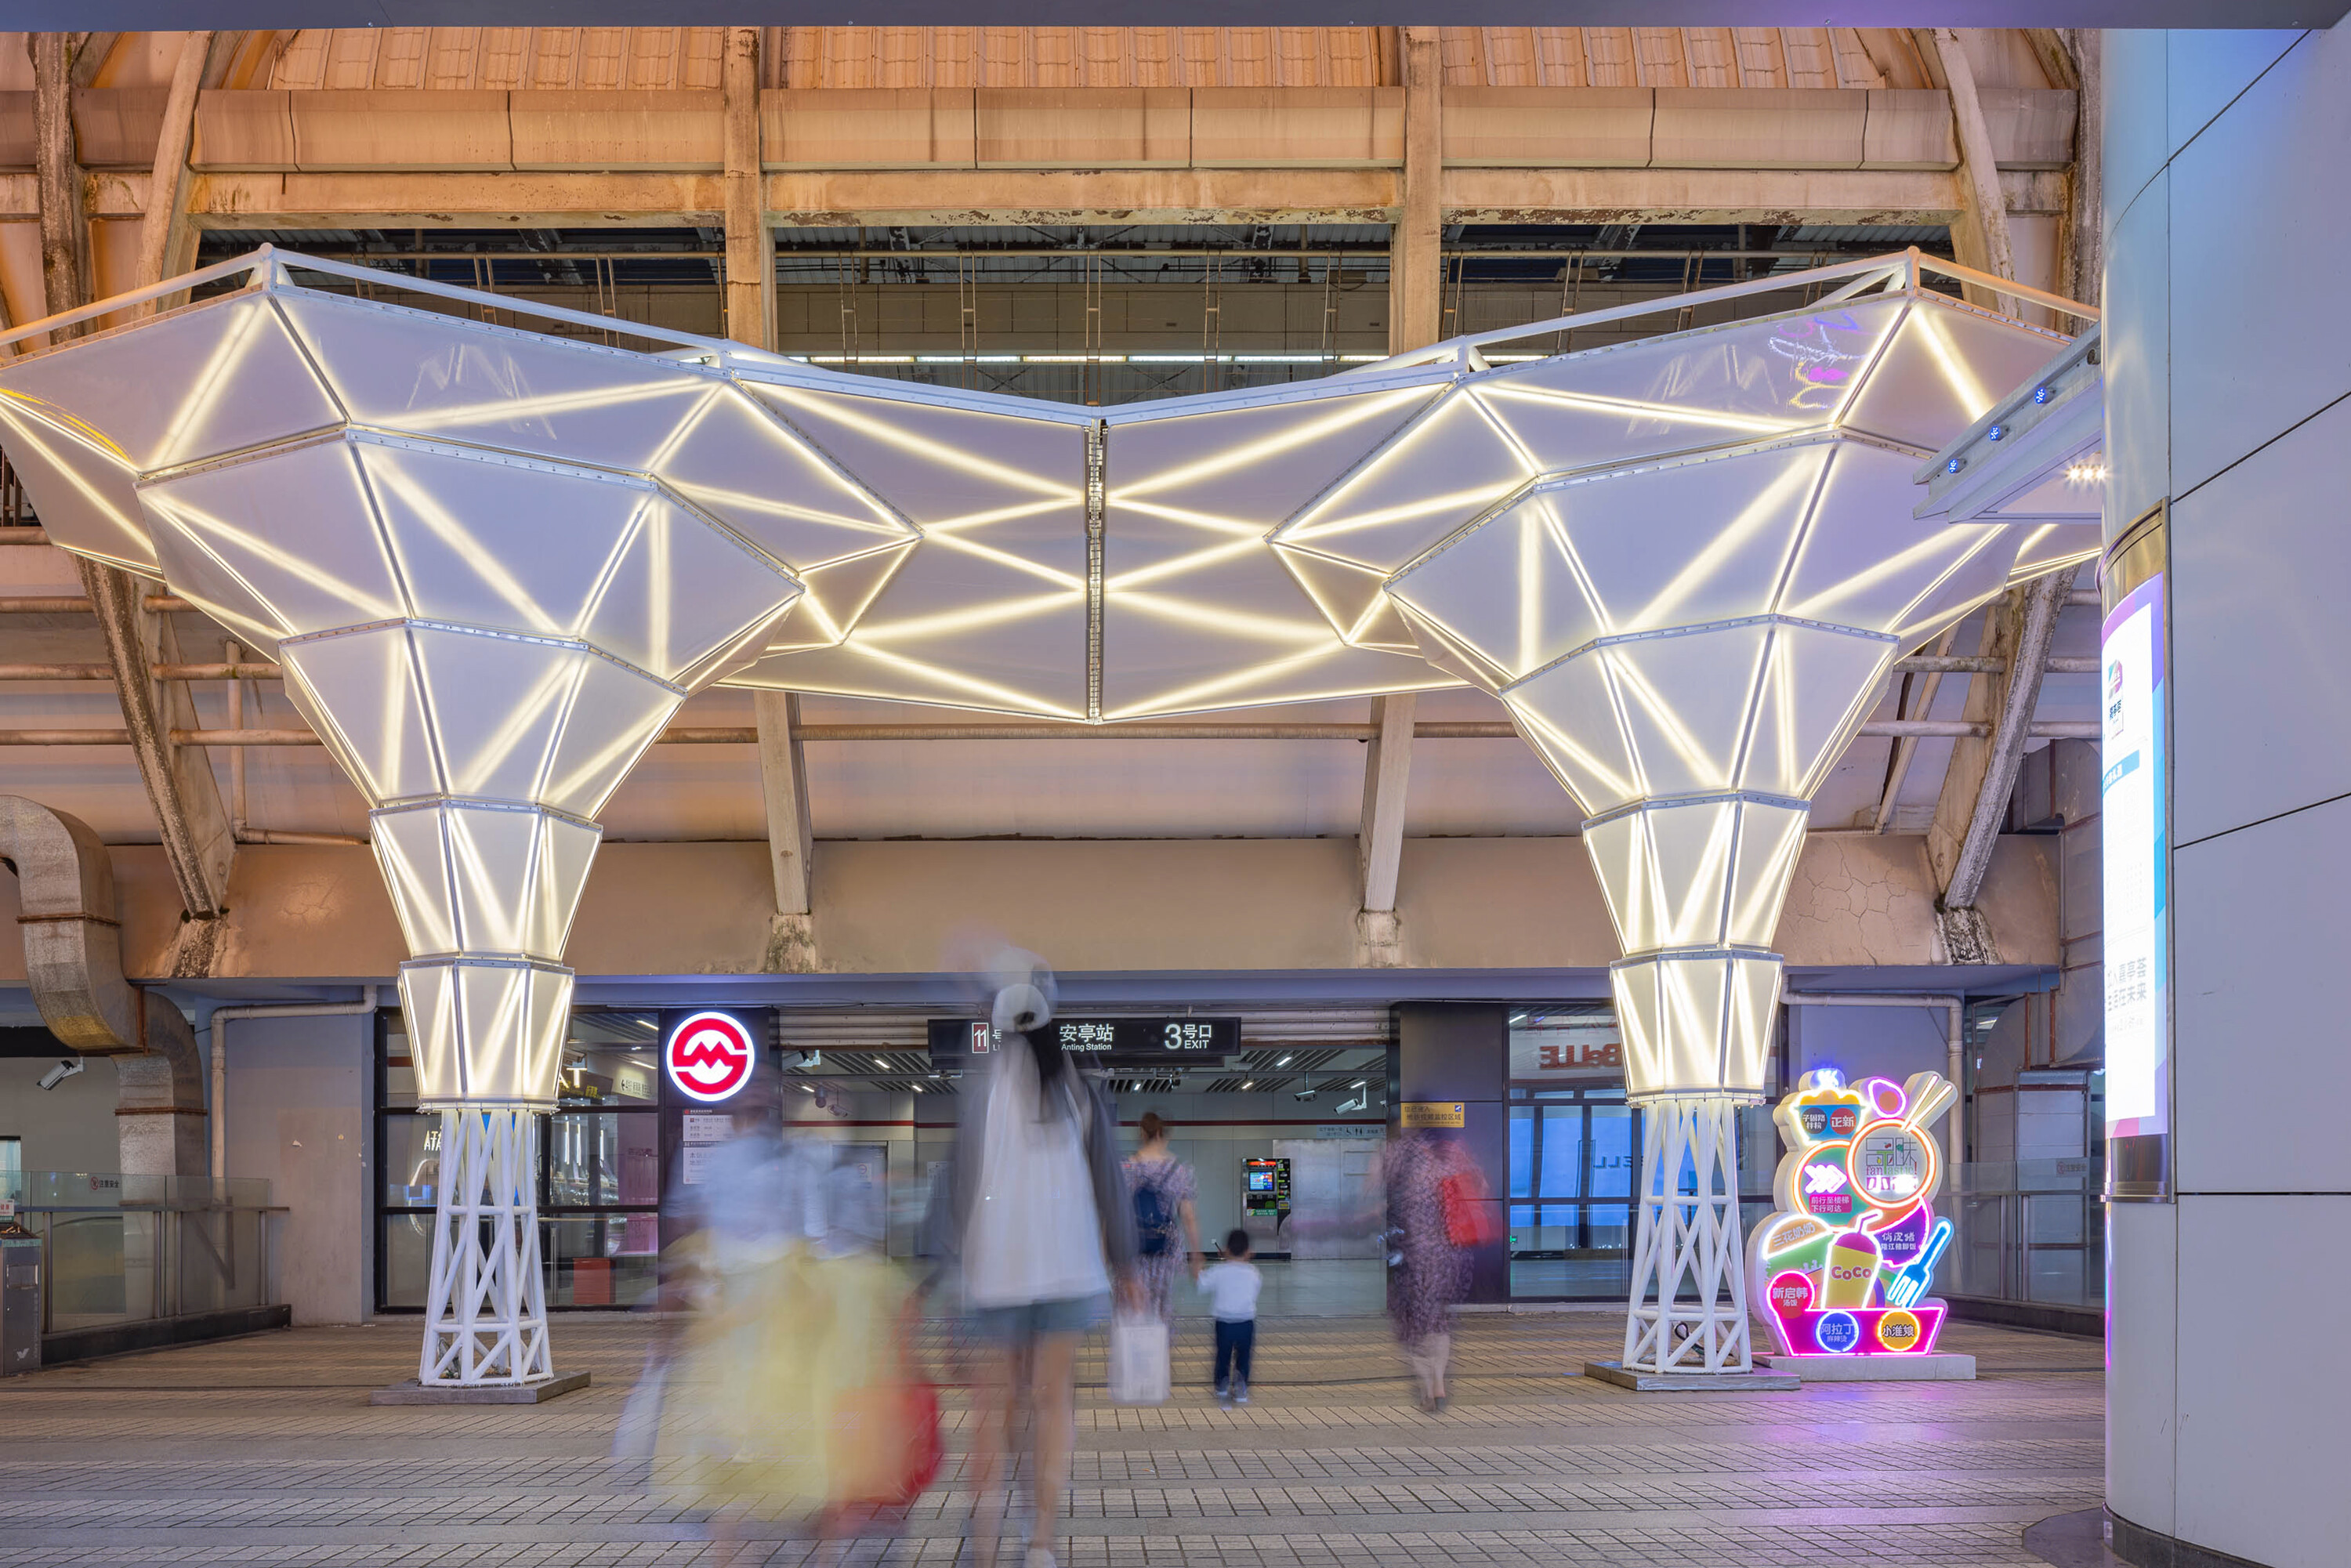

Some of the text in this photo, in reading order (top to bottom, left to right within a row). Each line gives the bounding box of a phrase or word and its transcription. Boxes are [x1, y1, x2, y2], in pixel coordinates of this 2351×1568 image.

[1060, 1023, 1114, 1042] 安亭站
[1061, 1044, 1085, 1052] Anting
[1184, 1040, 1209, 1049] EXIT
[1831, 1115, 1855, 1128] 正新
[1866, 1137, 1918, 1167] 品味
[1811, 1196, 1849, 1204] 前行至楼梯
[1772, 1222, 1816, 1247] 三花奶奶
[1831, 1266, 1872, 1280] CoCo
[1773, 1287, 1808, 1299] 新启韩
[1820, 1323, 1854, 1335] 阿拉丁
